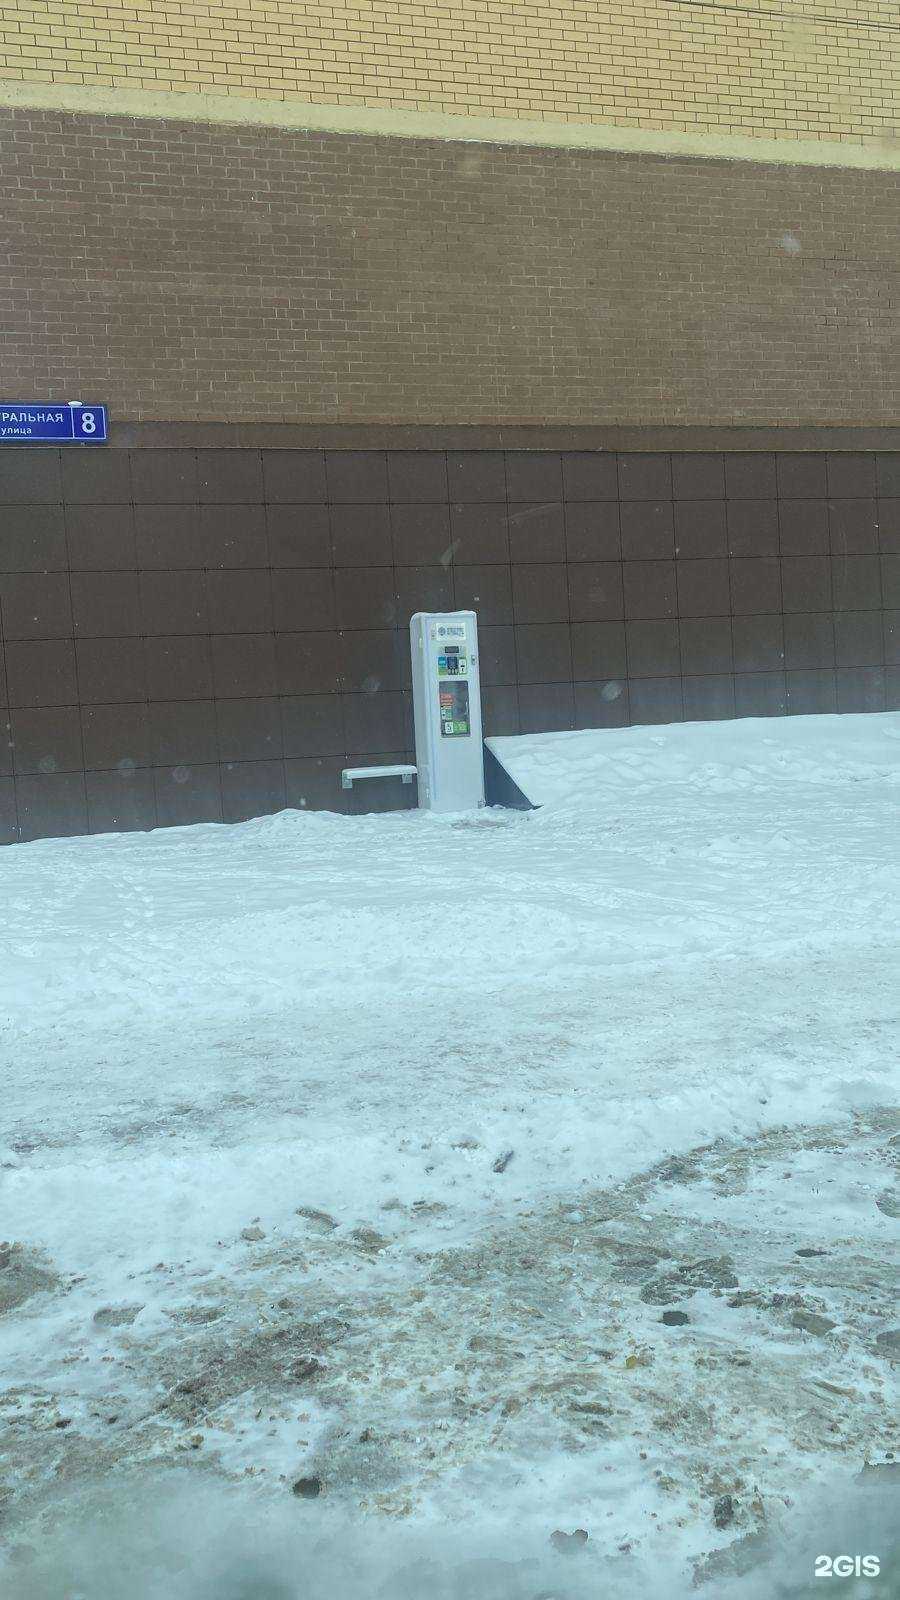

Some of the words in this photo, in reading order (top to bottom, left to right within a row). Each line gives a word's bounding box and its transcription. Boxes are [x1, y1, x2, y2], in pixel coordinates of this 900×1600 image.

[0, 412, 64, 423] РАЛЬНАЯ
[81, 412, 96, 434] 8
[1, 427, 32, 436] улица
